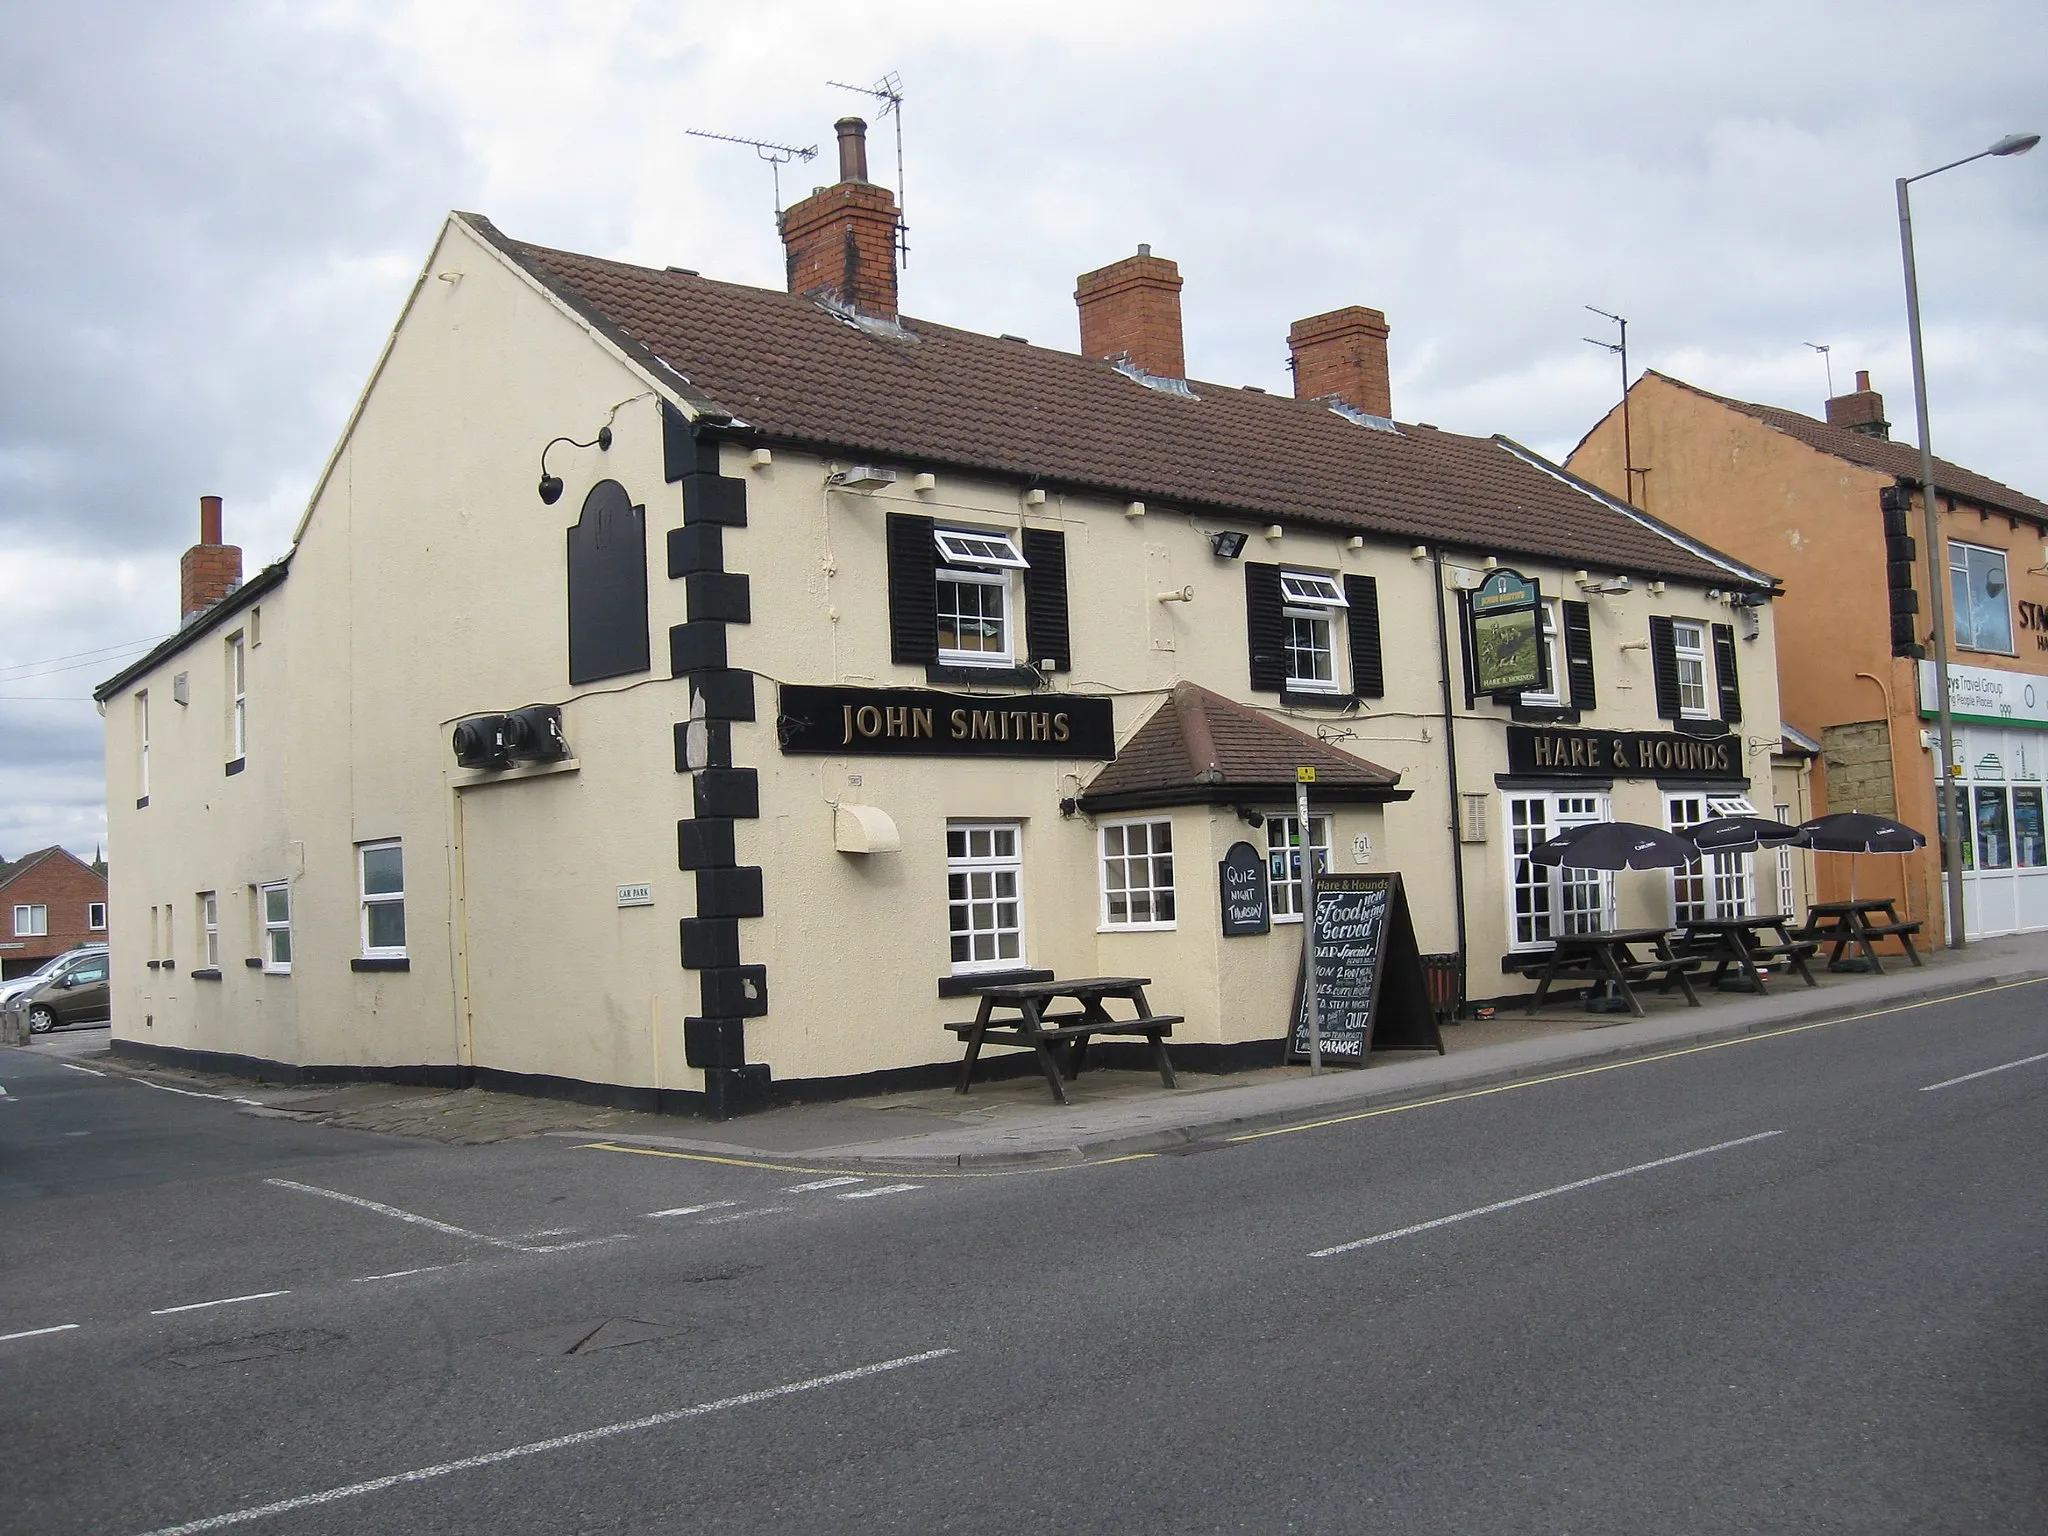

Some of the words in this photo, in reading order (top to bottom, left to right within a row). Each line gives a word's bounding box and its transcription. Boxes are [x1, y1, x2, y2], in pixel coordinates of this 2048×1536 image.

[1960, 675, 1981, 693] Travel
[1981, 678, 2003, 698] Group
[842, 705, 934, 745] JOHN
[951, 709, 1070, 742] SMITHS
[1534, 736, 1600, 767] HARE
[1613, 739, 1630, 768] &
[1639, 740, 1729, 770] HOUNDS
[1227, 866, 1256, 885] QUIZ
[1317, 880, 1340, 890] Hare
[1342, 880, 1349, 889] &
[1351, 879, 1389, 890] Hounds
[619, 889, 631, 898] CAR
[632, 888, 649, 897] PARK
[1230, 888, 1255, 900] NIGHT
[1316, 894, 1363, 925] Food
[1322, 919, 1373, 940] Served
[1336, 967, 1344, 978] 2
[1345, 1012, 1369, 1029] QUIZ
